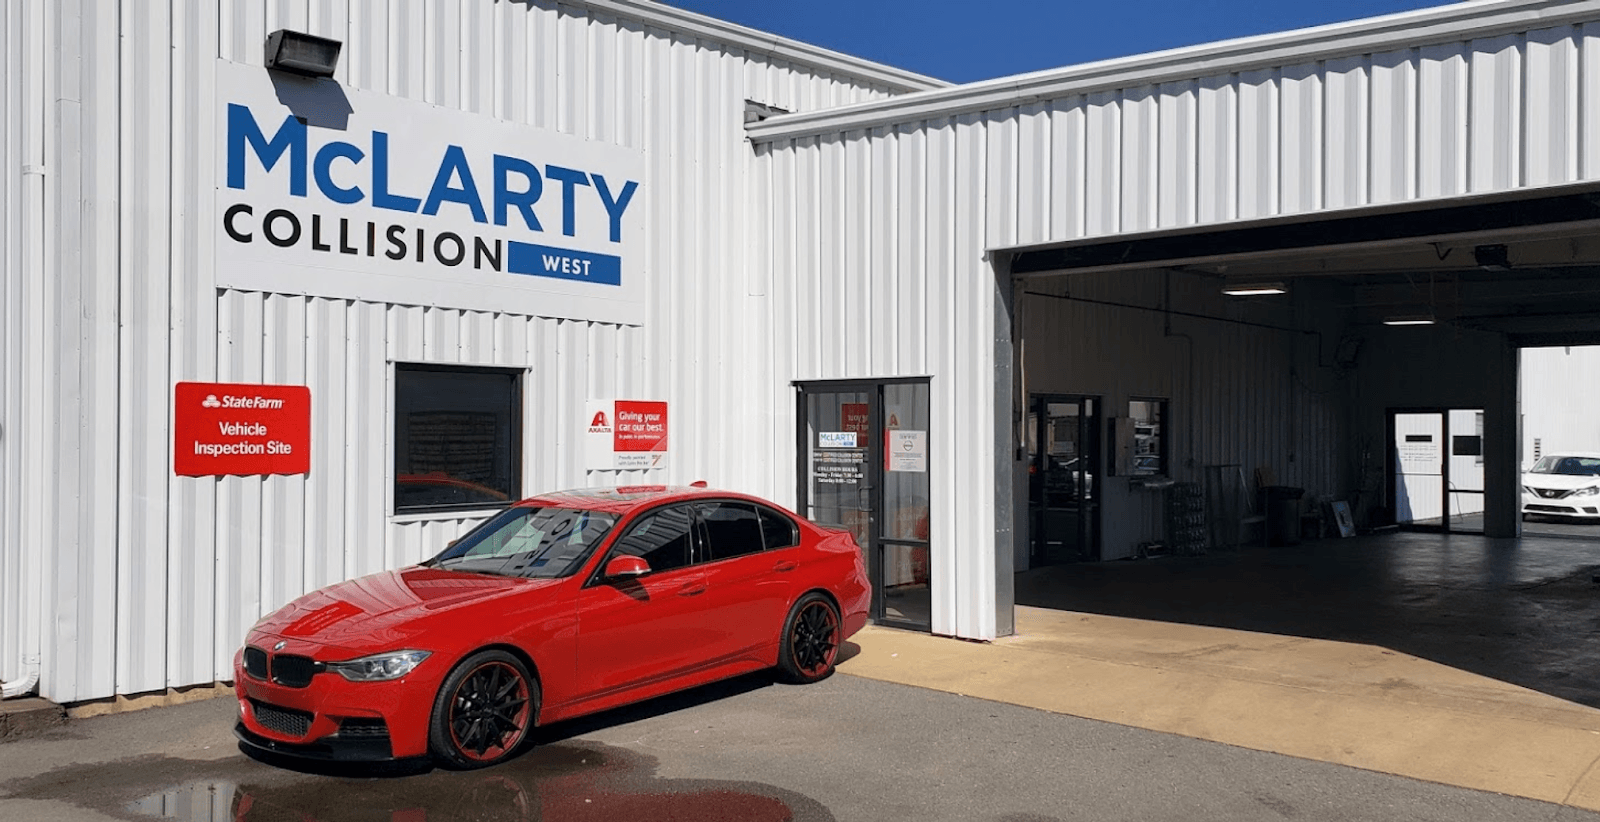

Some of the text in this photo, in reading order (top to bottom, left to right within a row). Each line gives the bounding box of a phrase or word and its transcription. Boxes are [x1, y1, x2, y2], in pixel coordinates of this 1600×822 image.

[227, 103, 639, 243] McLARTY
[223, 204, 501, 272] COLLISION
[543, 254, 591, 276] WEST
[619, 411, 660, 423] Giving your
[219, 421, 267, 436] Vehicle
[619, 423, 664, 432] car our best.
[820, 433, 856, 441] McLARTY
[194, 440, 292, 457] Inspection Site
